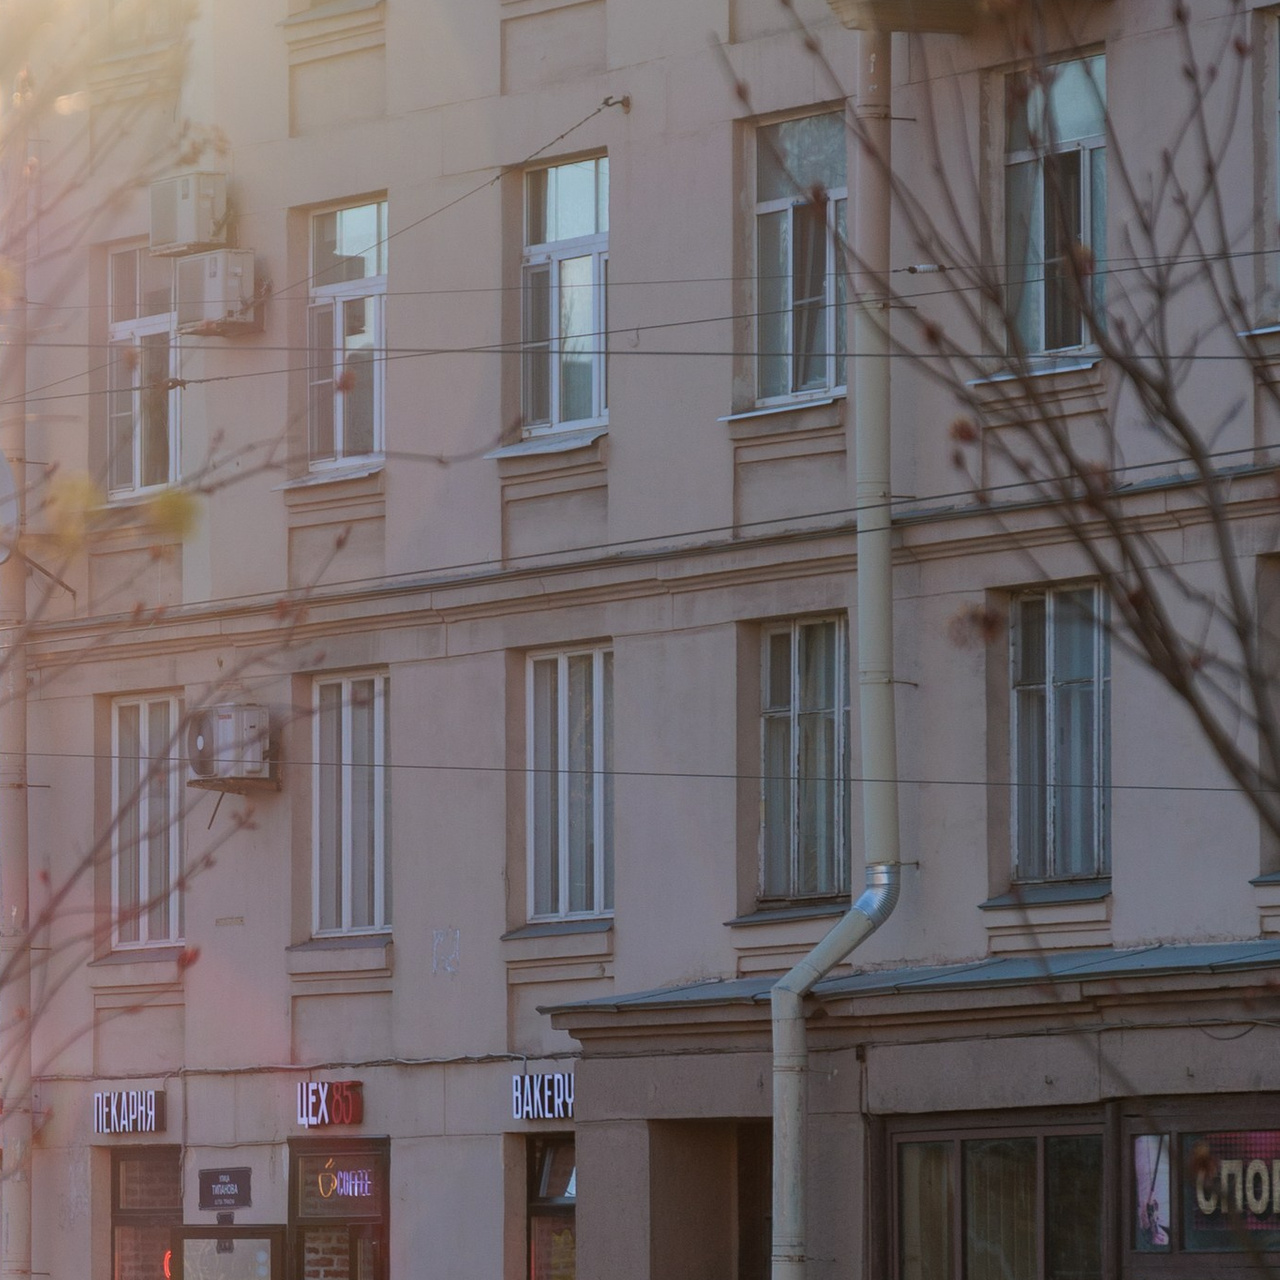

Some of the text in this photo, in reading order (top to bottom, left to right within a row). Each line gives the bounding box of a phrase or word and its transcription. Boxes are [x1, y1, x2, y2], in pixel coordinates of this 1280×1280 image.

[94, 1091, 155, 1133] ПЕКАРНЯ
[297, 1081, 352, 1129] ЦЕХ 85
[512, 1073, 574, 1119] BAKERY
